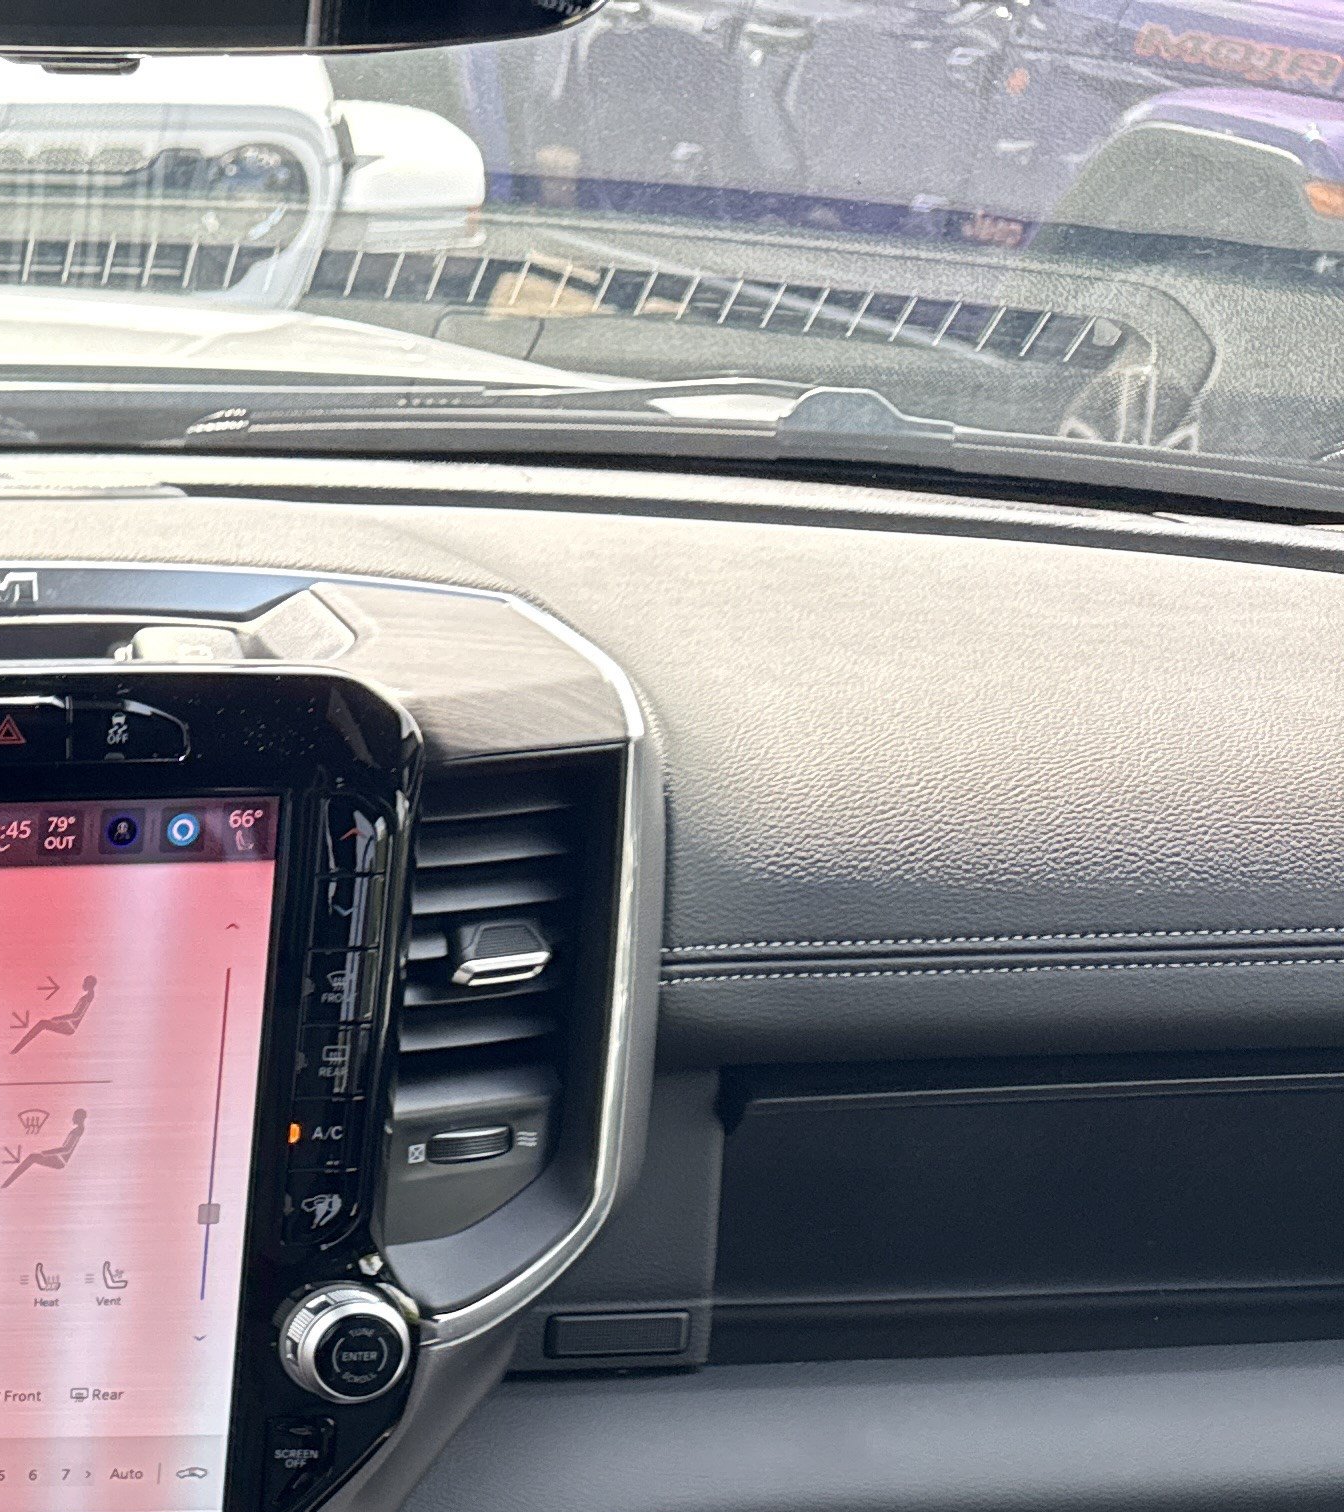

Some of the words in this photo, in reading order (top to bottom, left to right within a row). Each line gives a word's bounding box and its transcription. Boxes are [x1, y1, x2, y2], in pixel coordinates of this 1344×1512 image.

[107, 733, 129, 745] OFF
[47, 816, 76, 832] 79°
[228, 809, 264, 829] 66°
[44, 836, 76, 850] OUT
[311, 1126, 345, 1141] A/C
[33, 1297, 60, 1308] Heat
[95, 1296, 122, 1306] Vent
[341, 1351, 378, 1362] ENTER
[3, 1389, 43, 1403] Front
[91, 1388, 125, 1402] Rear
[274, 1449, 319, 1460] SCREEN
[285, 1459, 307, 1469] OFF
[28, 1469, 38, 1481] 6
[61, 1469, 71, 1481] 7
[109, 1467, 144, 1480] Auto
